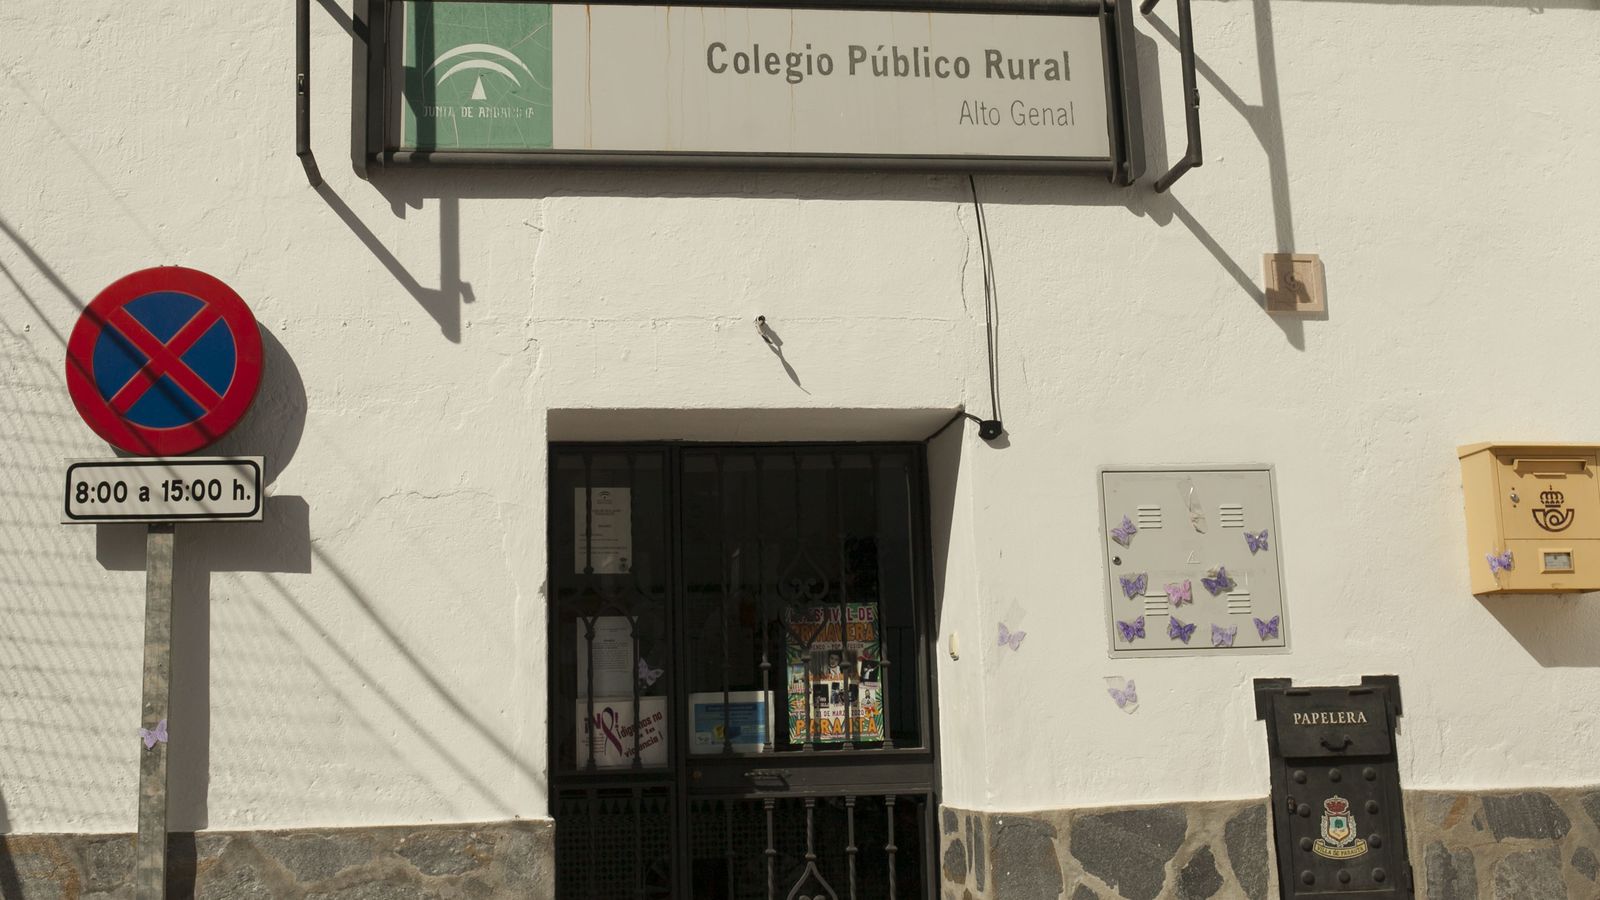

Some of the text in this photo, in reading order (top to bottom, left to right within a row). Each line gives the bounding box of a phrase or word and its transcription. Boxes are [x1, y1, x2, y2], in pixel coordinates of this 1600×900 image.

[706, 41, 1071, 83] Colegio Público Rural
[462, 106, 474, 118] DE
[479, 106, 535, 119] ANDAIA
[959, 99, 1075, 127] Alto Genal
[75, 479, 251, 504] 8:00 a 15:00 h.
[1293, 711, 1367, 725] PAPELERA
